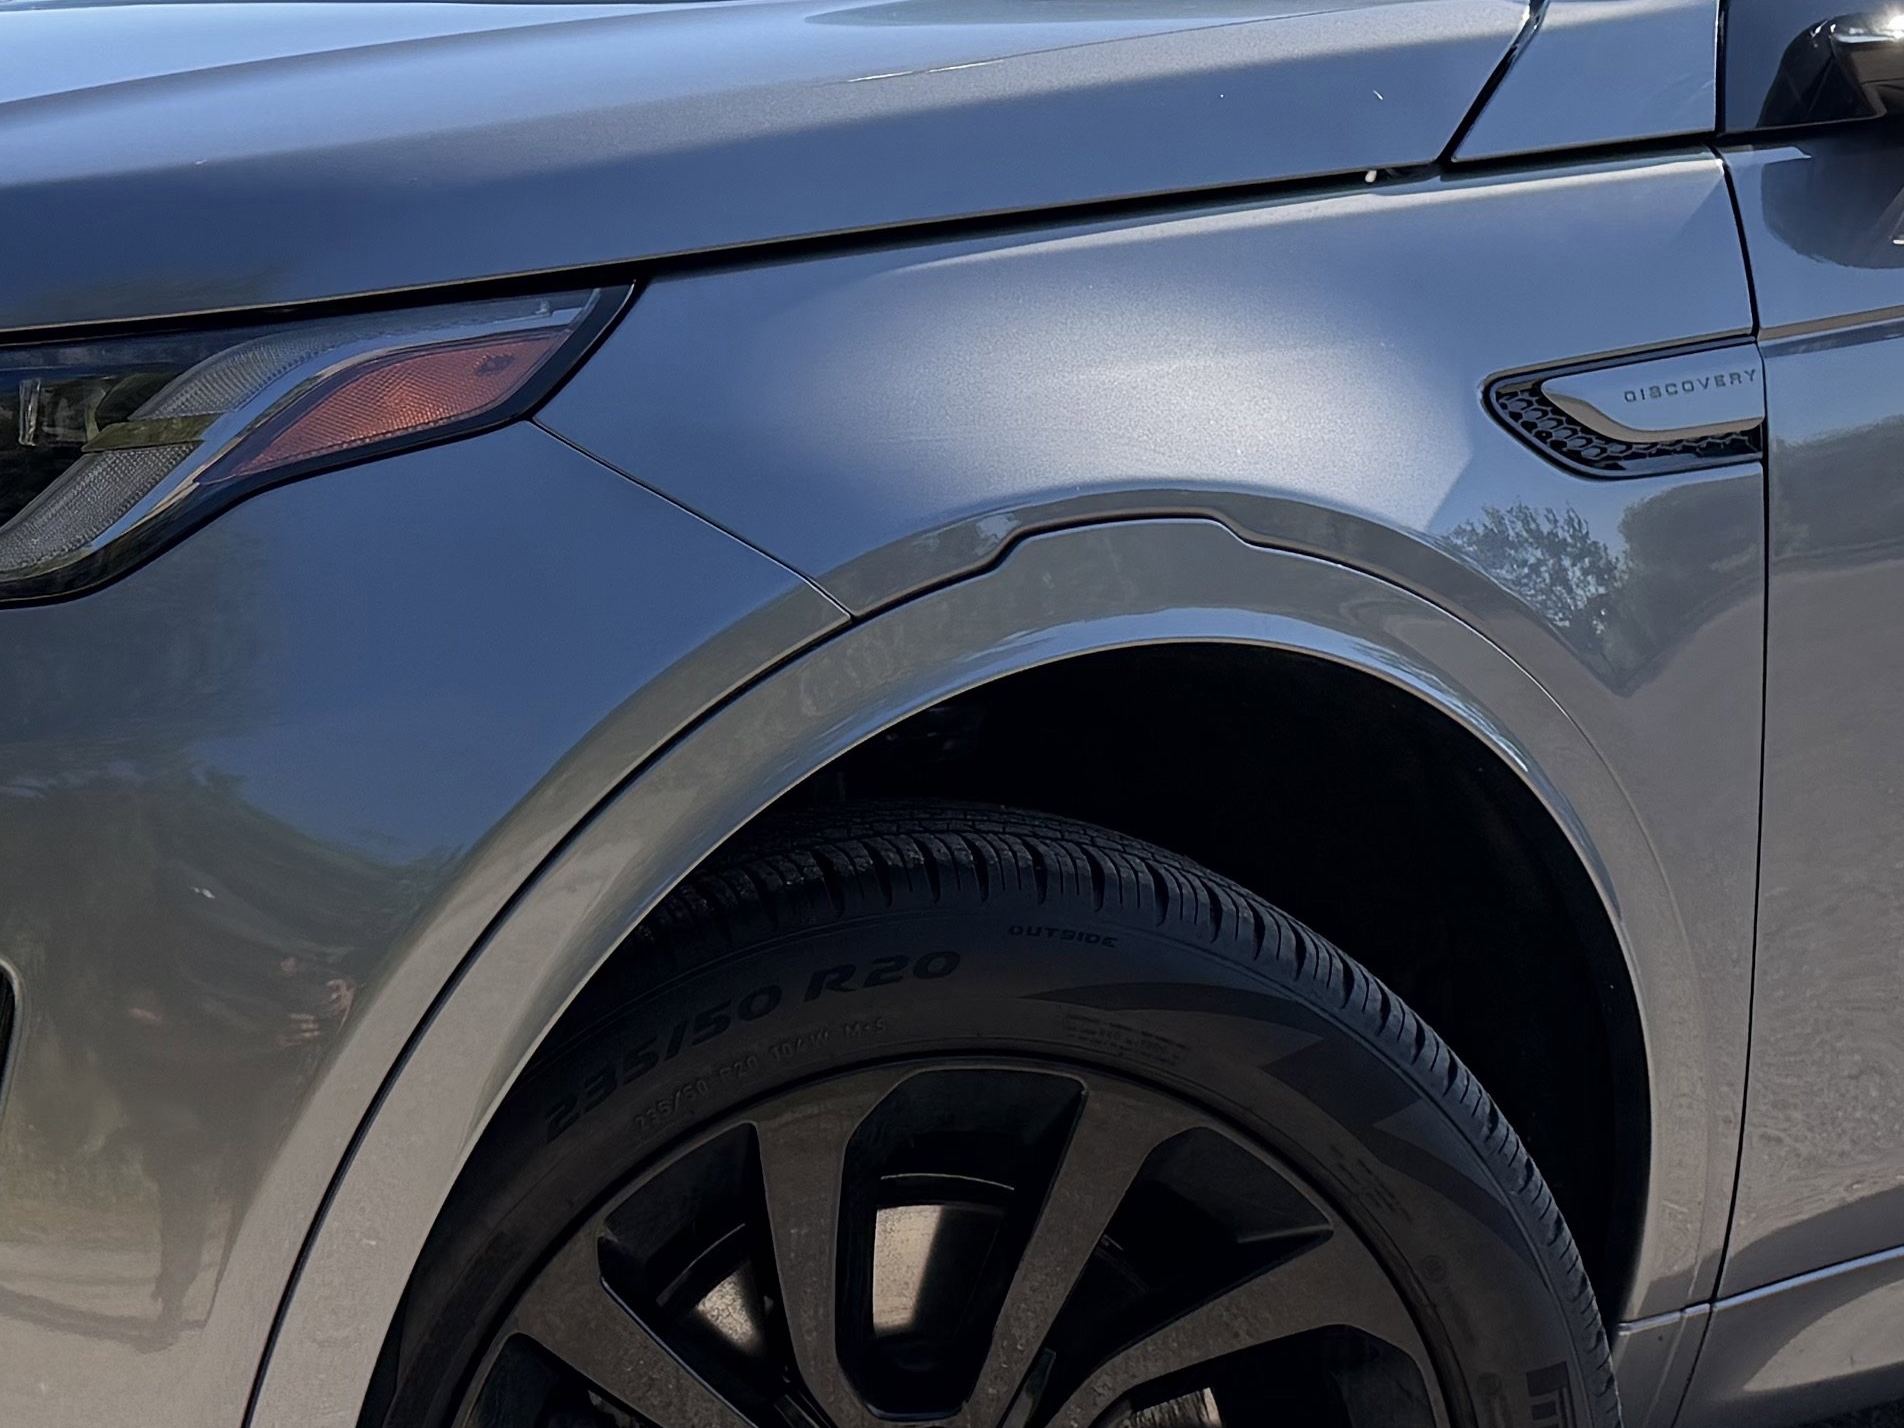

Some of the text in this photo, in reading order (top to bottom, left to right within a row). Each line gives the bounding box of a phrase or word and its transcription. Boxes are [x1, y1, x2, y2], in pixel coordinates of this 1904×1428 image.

[1624, 369, 1756, 403] DISCOVERY
[1007, 924, 1119, 948] OUTSIDE
[803, 950, 962, 1003] R20
